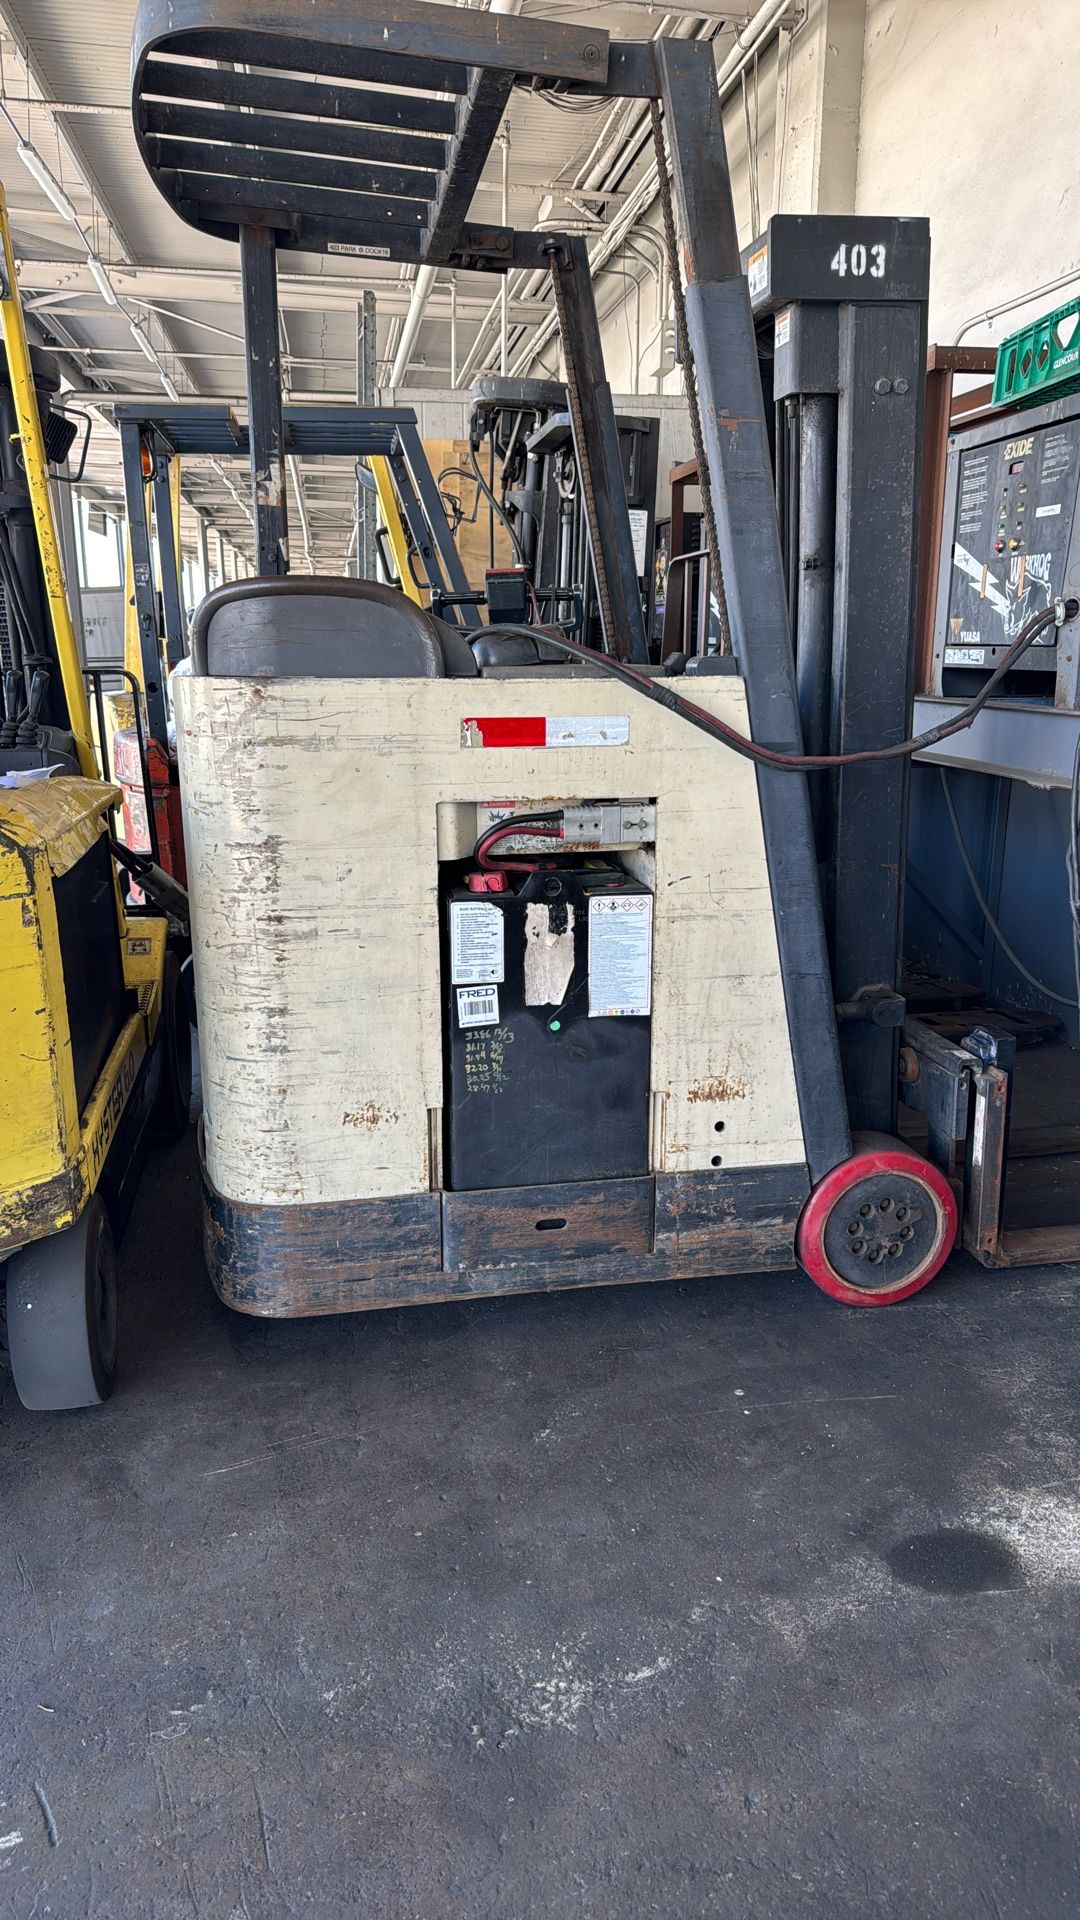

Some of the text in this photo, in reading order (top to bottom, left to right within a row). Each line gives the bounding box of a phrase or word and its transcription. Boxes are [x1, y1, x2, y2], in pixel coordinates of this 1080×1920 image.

[830, 243, 886, 278] 403
[1003, 437, 1035, 460] EXIDE
[960, 631, 980, 643] YUASA
[459, 988, 496, 999] FRED
[92, 1073, 124, 1177] HYSTER
